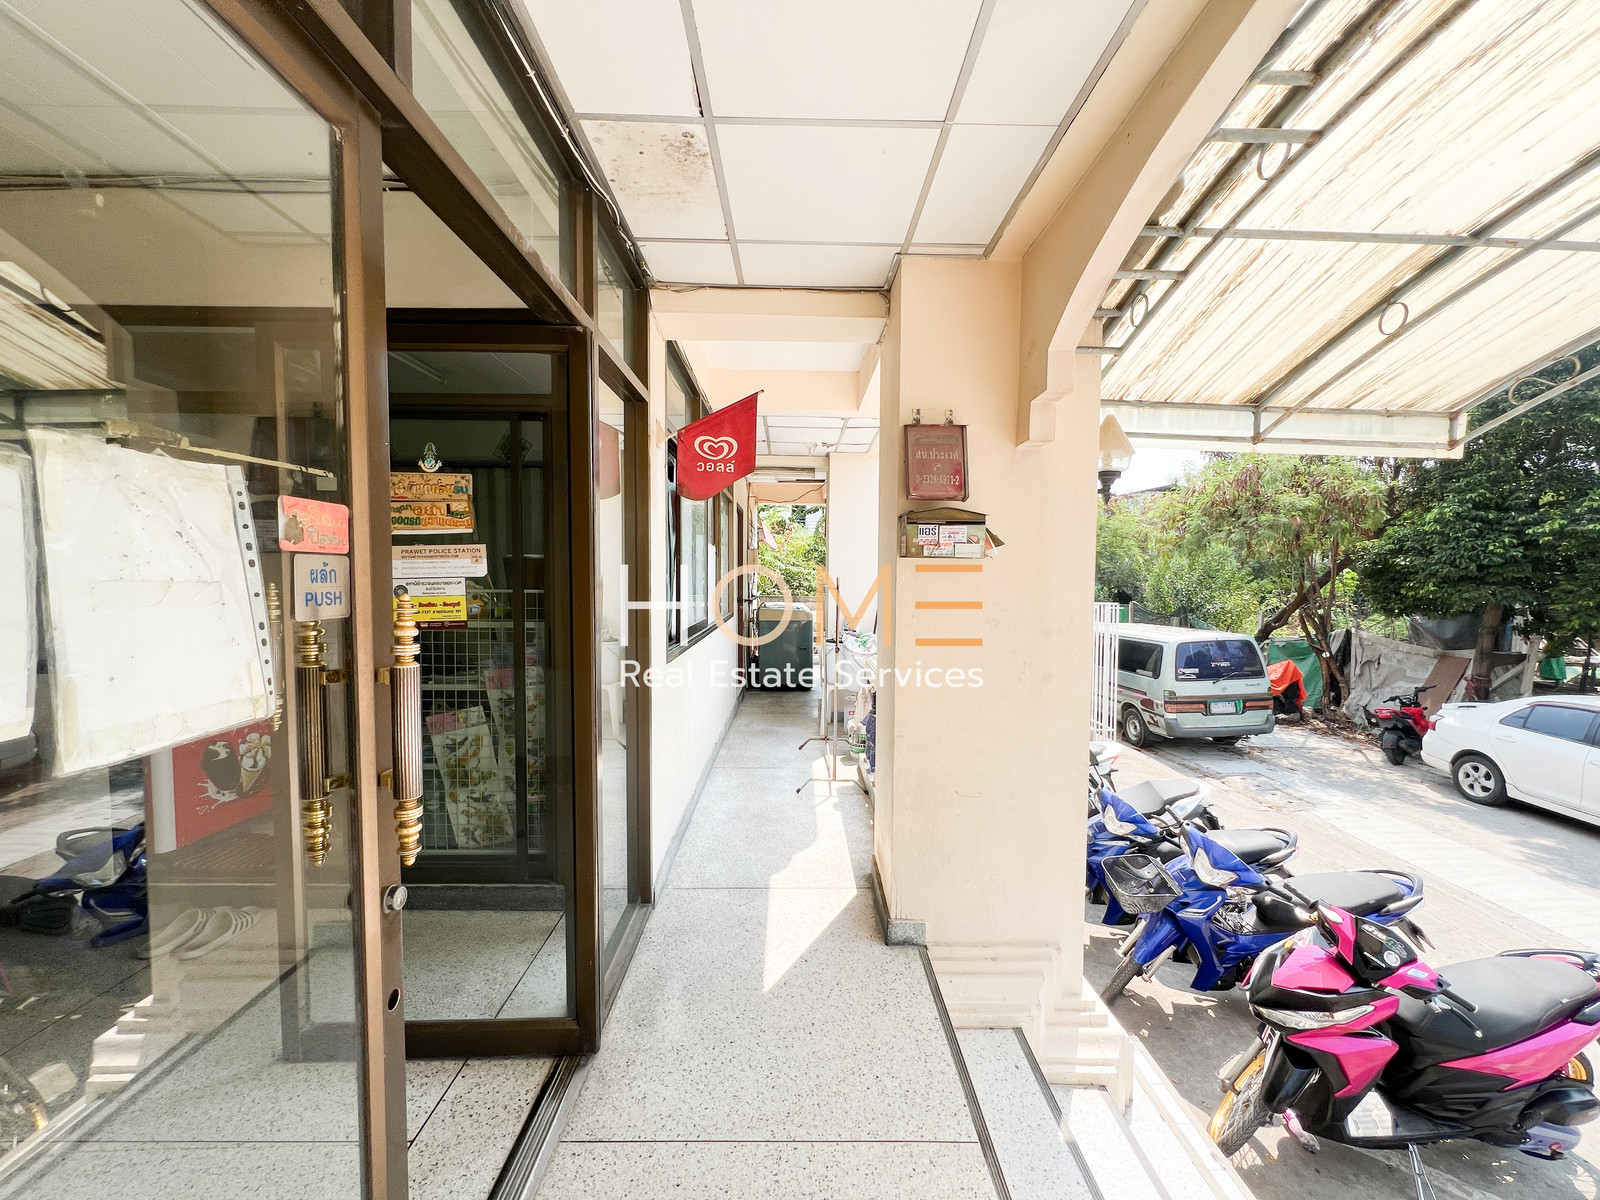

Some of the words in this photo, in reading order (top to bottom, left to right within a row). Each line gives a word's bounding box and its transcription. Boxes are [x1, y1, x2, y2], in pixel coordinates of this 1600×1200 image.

[915, 448, 960, 460] สน.ประเวศ
[696, 460, 736, 473] วอลล์
[413, 503, 445, 516] อย่า
[919, 525, 937, 536] แอร์
[428, 547, 452, 555] POLICE
[309, 561, 337, 584] ผลัก
[305, 591, 342, 607] PUSH
